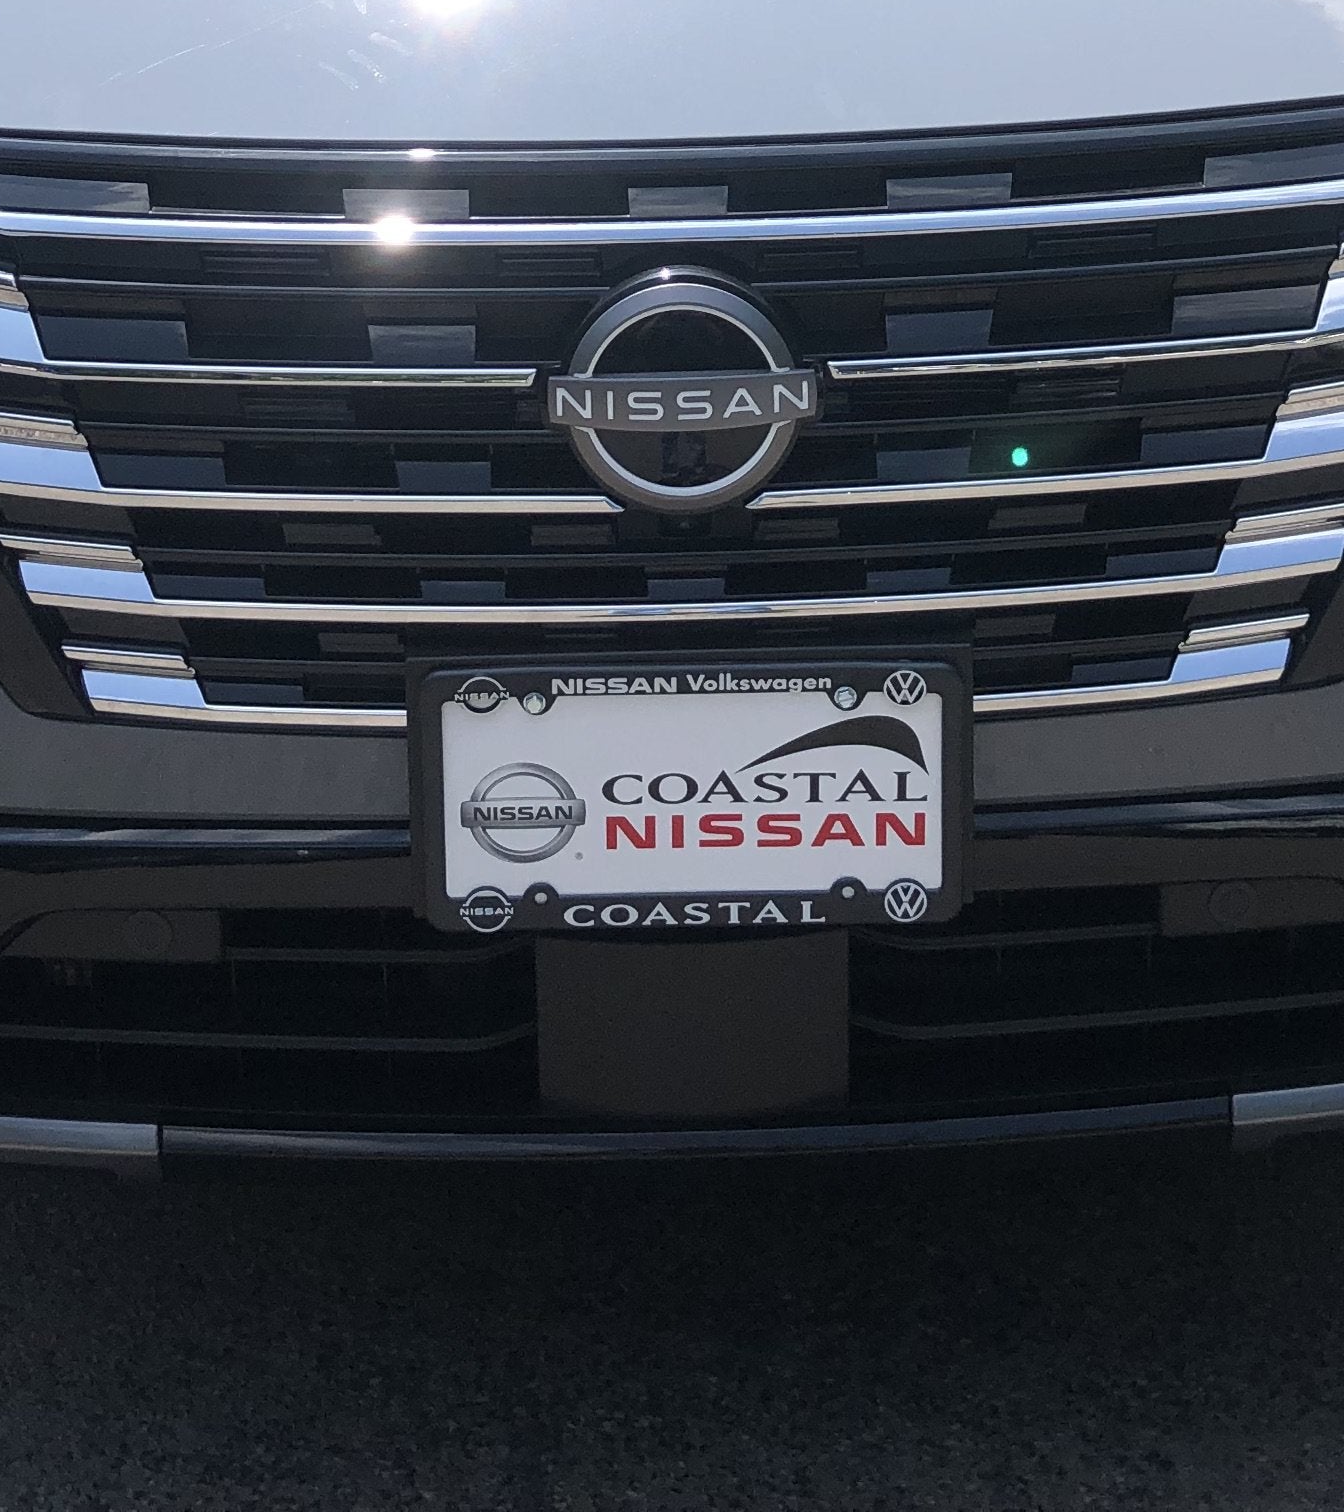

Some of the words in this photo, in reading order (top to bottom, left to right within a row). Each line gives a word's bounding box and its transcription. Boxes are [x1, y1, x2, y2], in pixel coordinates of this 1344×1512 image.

[556, 380, 810, 421] NISSAN
[552, 677, 678, 694] NISSAN
[686, 674, 832, 693] Volkswagen
[454, 691, 511, 701] NISSAN
[602, 769, 928, 804] COASTAL
[473, 805, 574, 822] NISSAN
[606, 812, 926, 849] NISSAN
[459, 906, 514, 916] NISSAN
[564, 901, 825, 926] COASTAL
